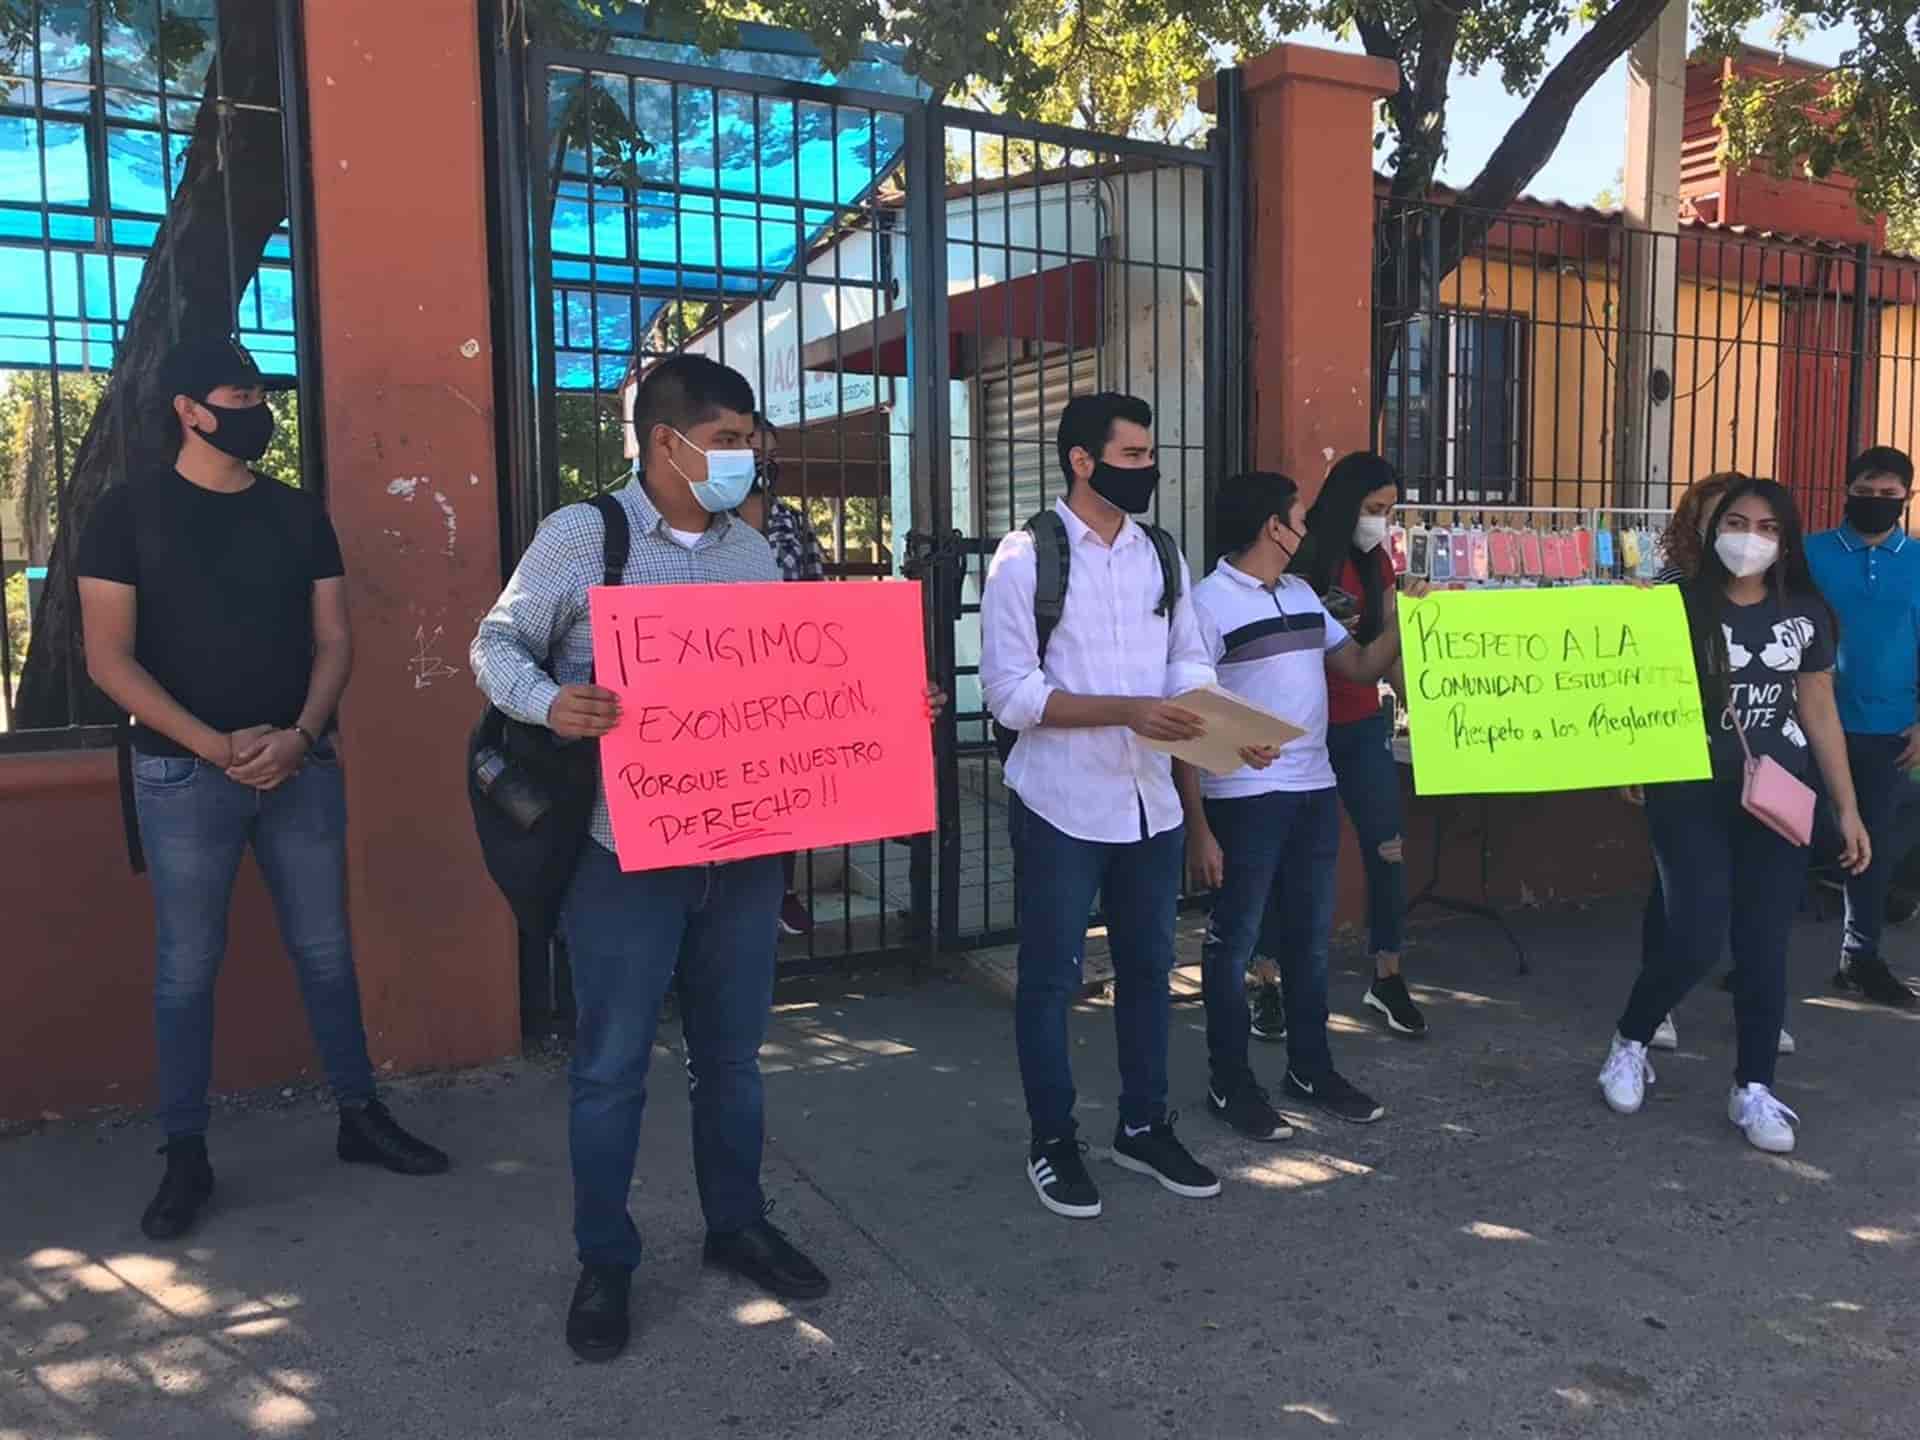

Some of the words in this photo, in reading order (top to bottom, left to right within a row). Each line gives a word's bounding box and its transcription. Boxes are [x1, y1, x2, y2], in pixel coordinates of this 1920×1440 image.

[1408, 600, 1550, 663] RESPETO
[1562, 628, 1585, 662] A
[1593, 624, 1640, 660] LA
[1419, 669, 1544, 701] COMUNIDAD
[1729, 683, 1782, 705] TWO
[1449, 702, 1524, 753] Respeto
[1551, 718, 1580, 738] los
[1720, 707, 1777, 731] CUTE
[618, 761, 730, 801] PORQUE
[742, 760, 771, 785] ES
[778, 741, 884, 776] NUESTRO
